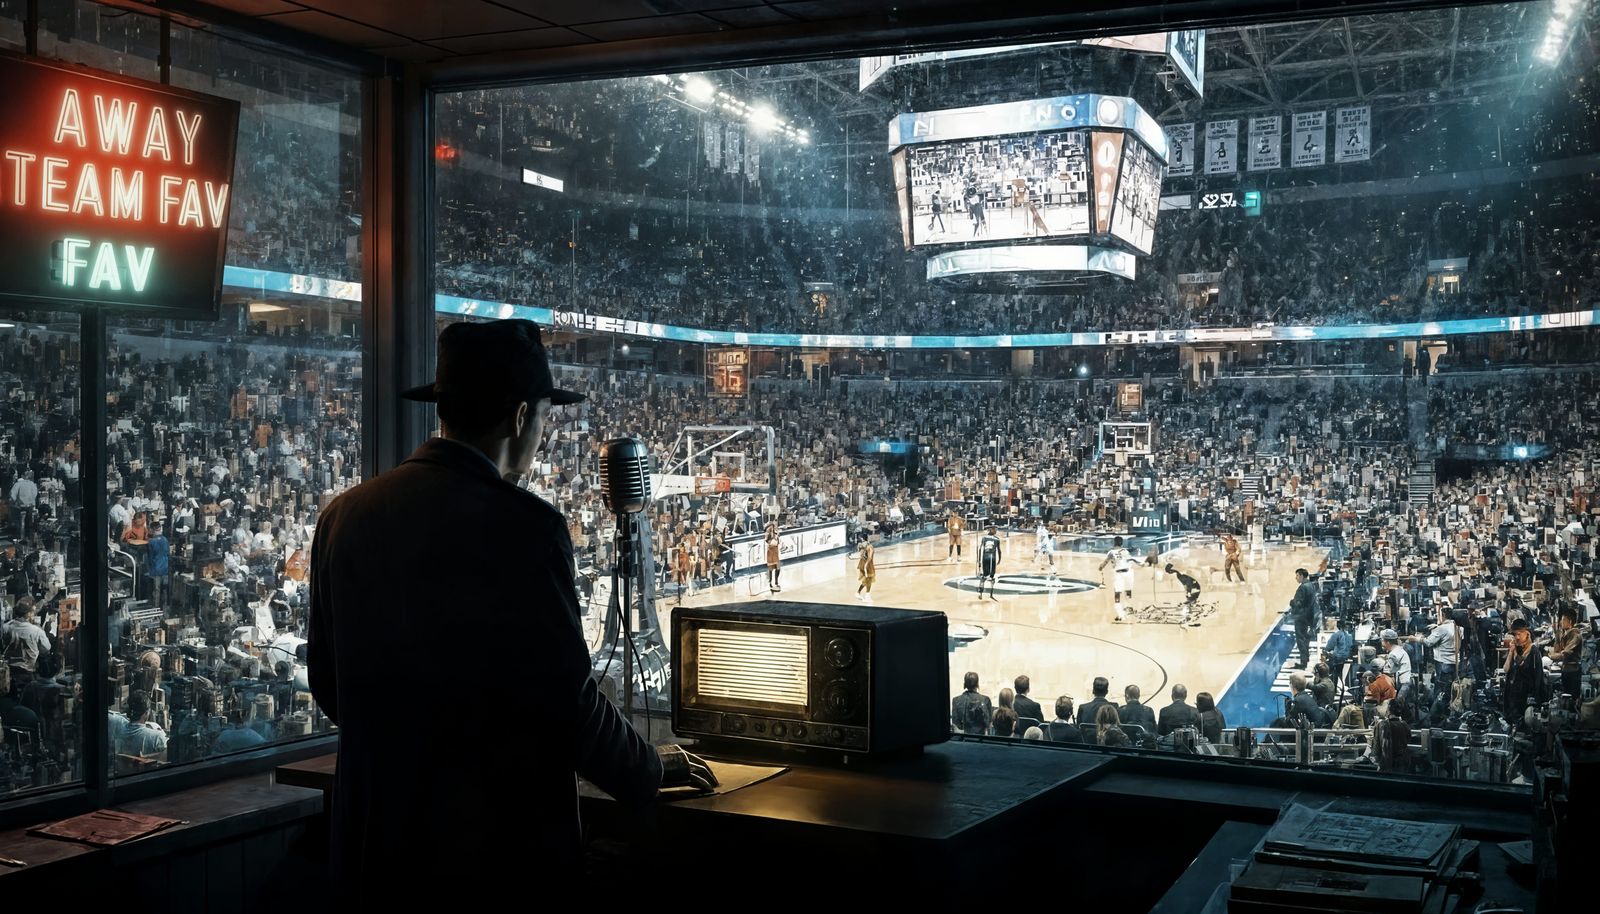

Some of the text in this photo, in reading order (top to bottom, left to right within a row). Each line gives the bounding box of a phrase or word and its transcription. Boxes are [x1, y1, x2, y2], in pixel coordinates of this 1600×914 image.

[54, 88, 202, 165] AWAY
[5, 150, 229, 229] TEAM FAV
[61, 237, 155, 292] FAV
